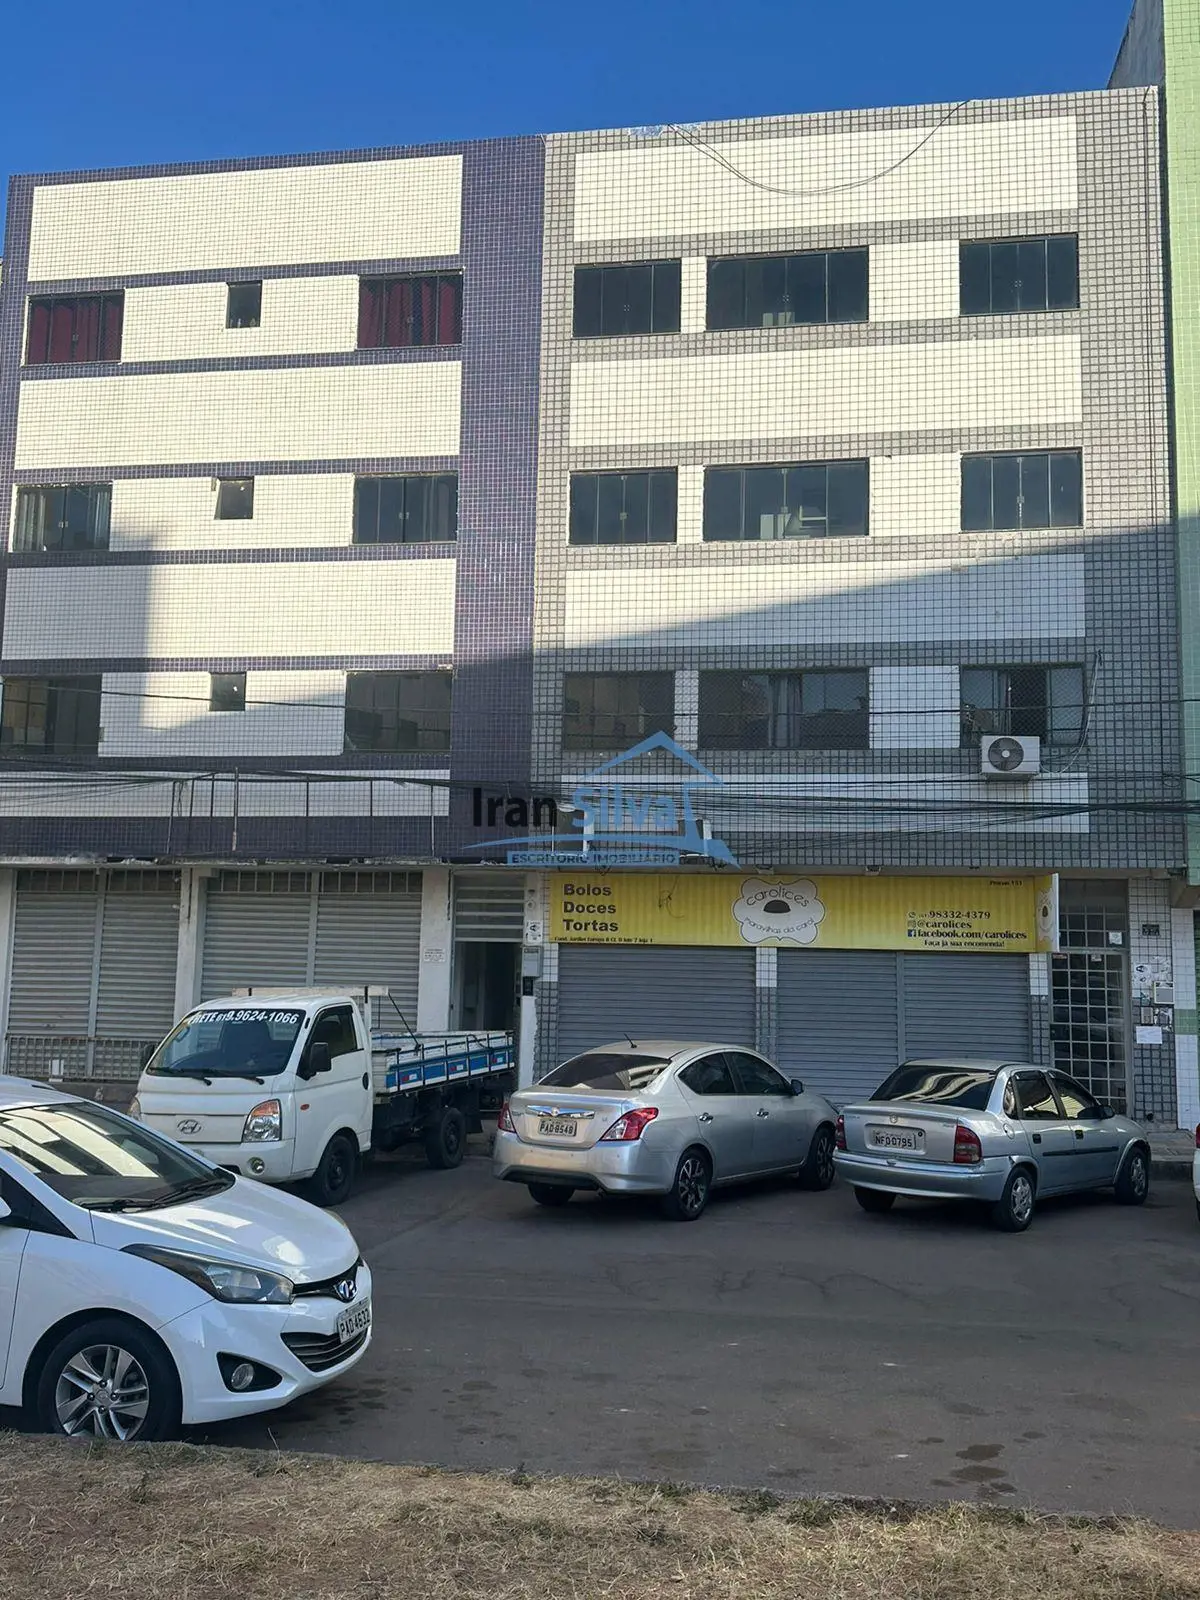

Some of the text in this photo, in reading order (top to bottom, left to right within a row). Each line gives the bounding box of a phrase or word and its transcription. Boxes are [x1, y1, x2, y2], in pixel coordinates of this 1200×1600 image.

[563, 883, 612, 896] Bolos
[746, 885, 810, 907] carolices
[563, 901, 617, 914] Doces
[929, 910, 991, 919] 98332-4379
[562, 919, 619, 932] Tortas
[917, 920, 973, 929] @carolices
[918, 929, 1027, 939] facebook.com/carolices
[924, 939, 940, 947] Faça
